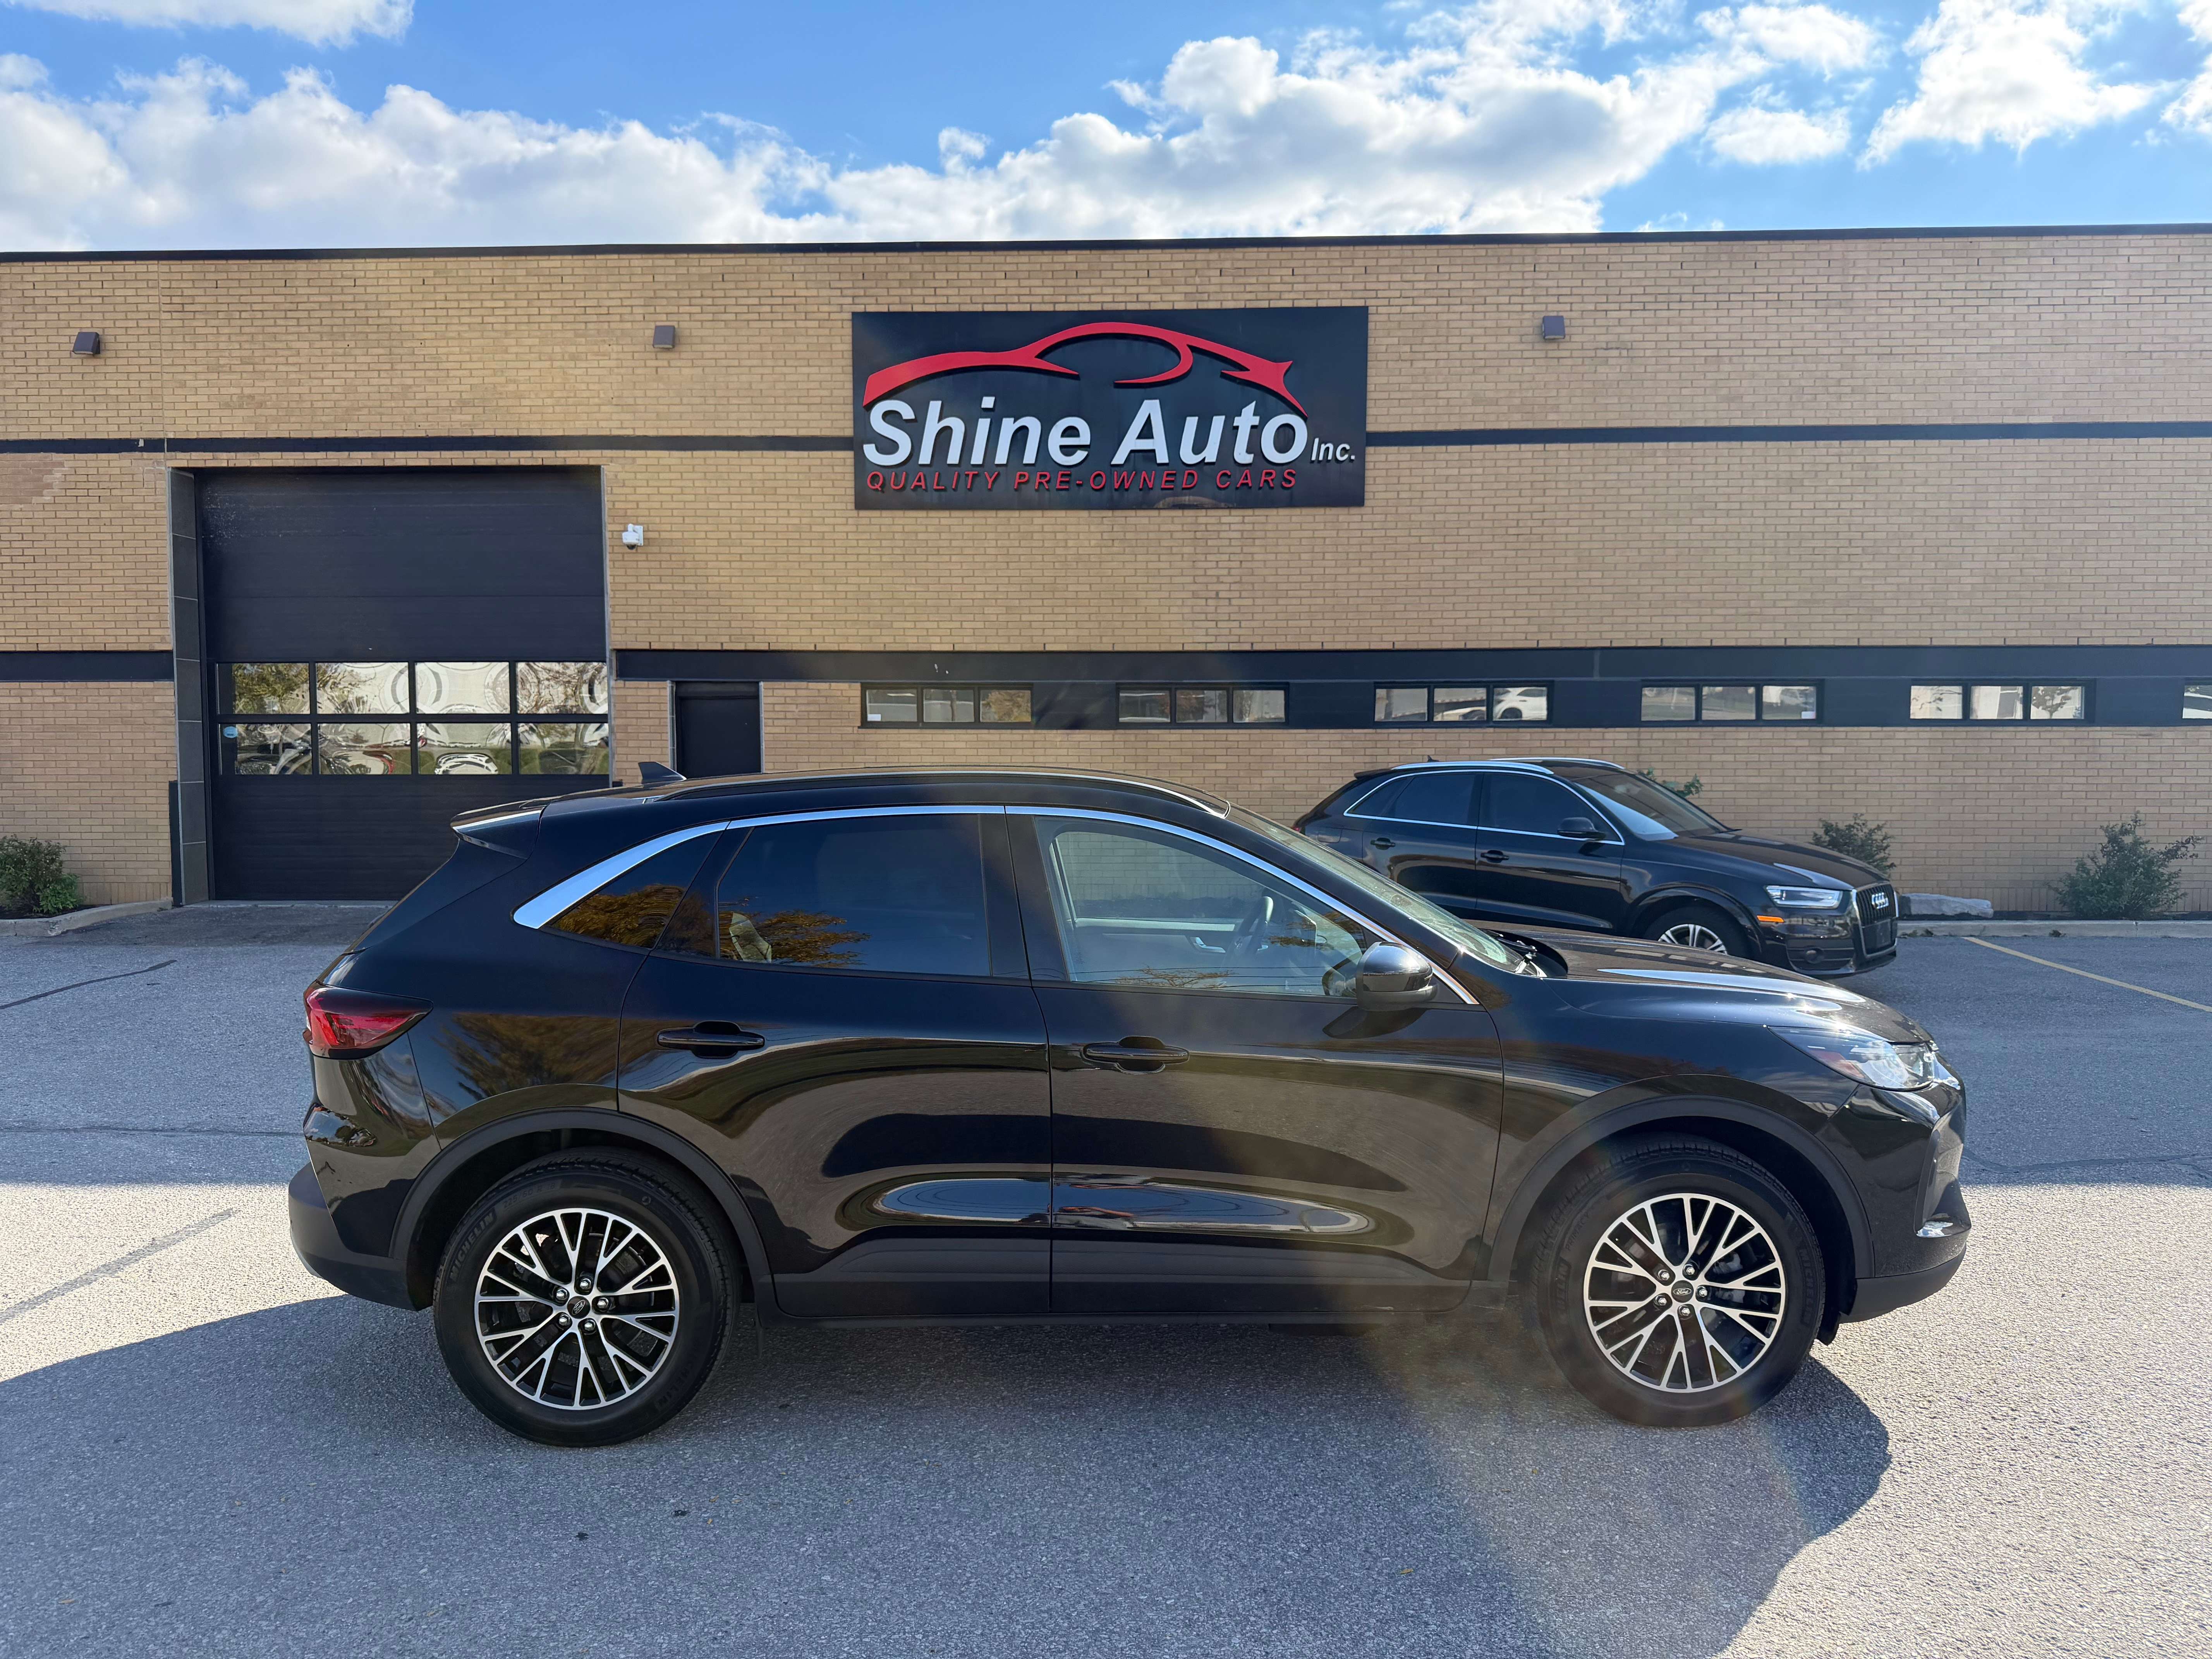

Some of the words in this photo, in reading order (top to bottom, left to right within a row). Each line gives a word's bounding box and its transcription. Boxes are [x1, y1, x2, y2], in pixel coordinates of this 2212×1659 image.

[862, 397, 1091, 466] Shine
[1111, 399, 1308, 465] Auto
[1311, 438, 1356, 461] Inc.
[867, 471, 998, 490] QUALITY
[1014, 469, 1198, 489] PRE-OWNED
[1216, 469, 1296, 488] CARS
[449, 1212, 495, 1281] MICHELIN
[1799, 1248, 1814, 1324] MICHELIN
